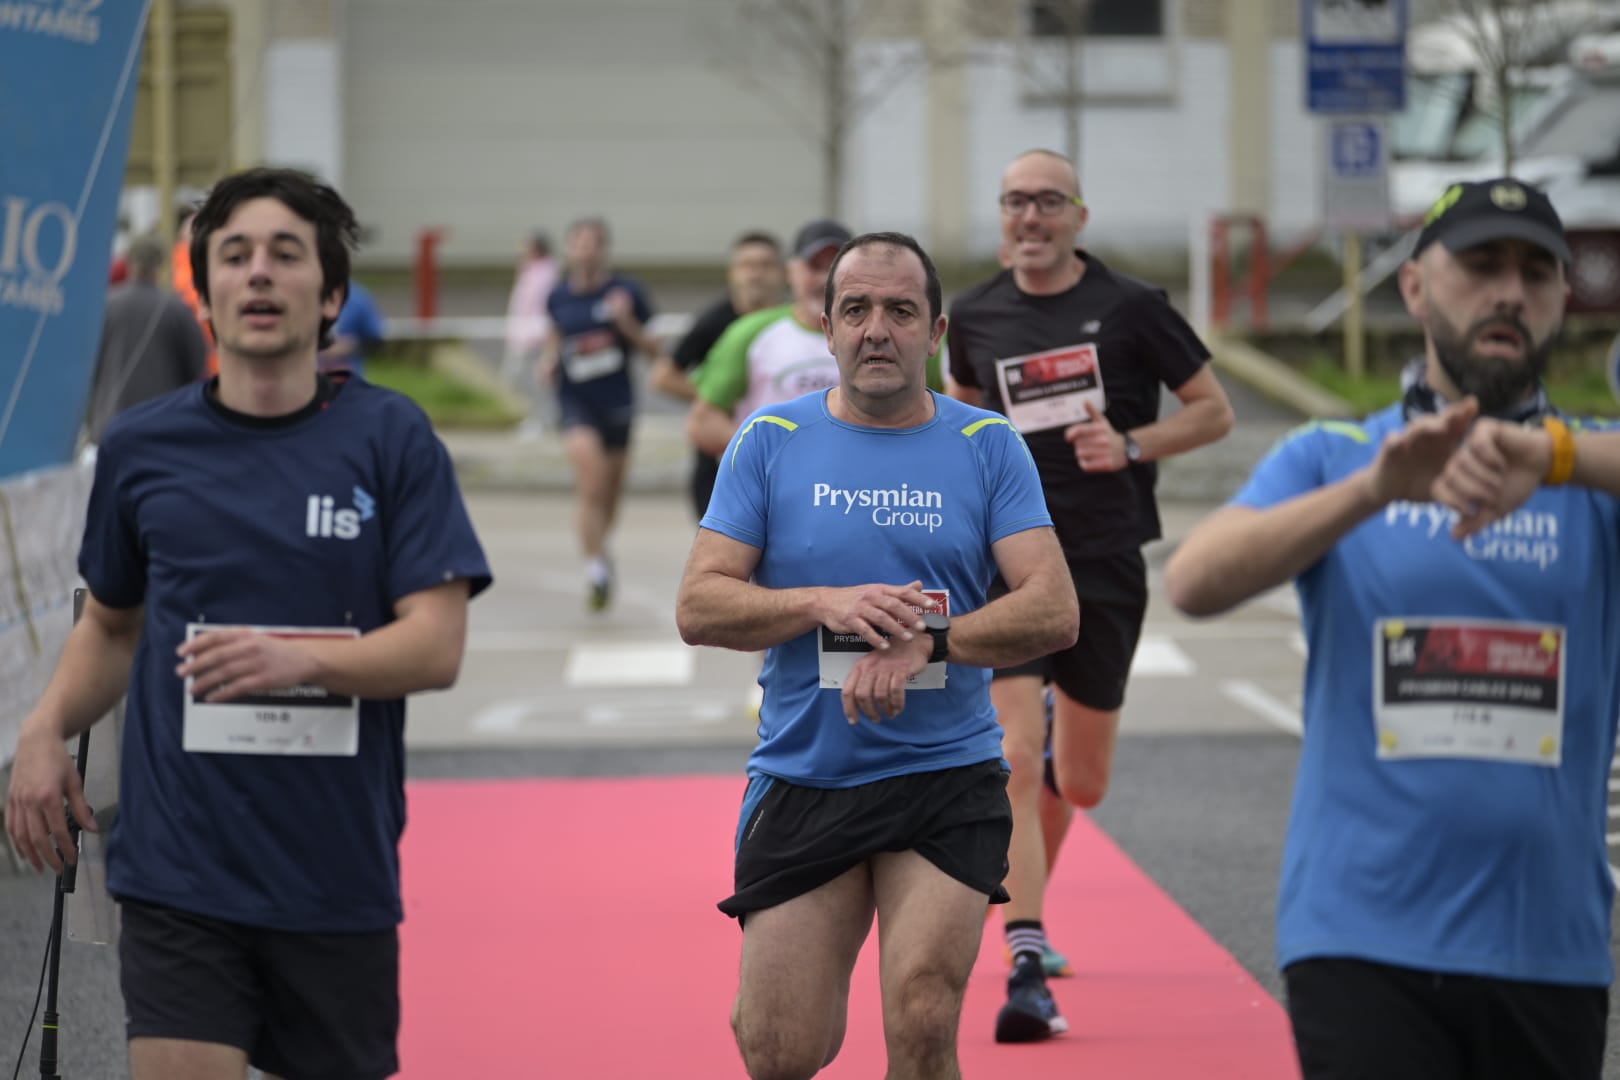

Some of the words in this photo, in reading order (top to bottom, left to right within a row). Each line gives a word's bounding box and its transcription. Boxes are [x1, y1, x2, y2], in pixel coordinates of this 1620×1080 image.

[813, 483, 943, 514] Prysmian
[306, 495, 361, 540] lis
[872, 506, 943, 534] Group
[1464, 533, 1559, 572] Group
